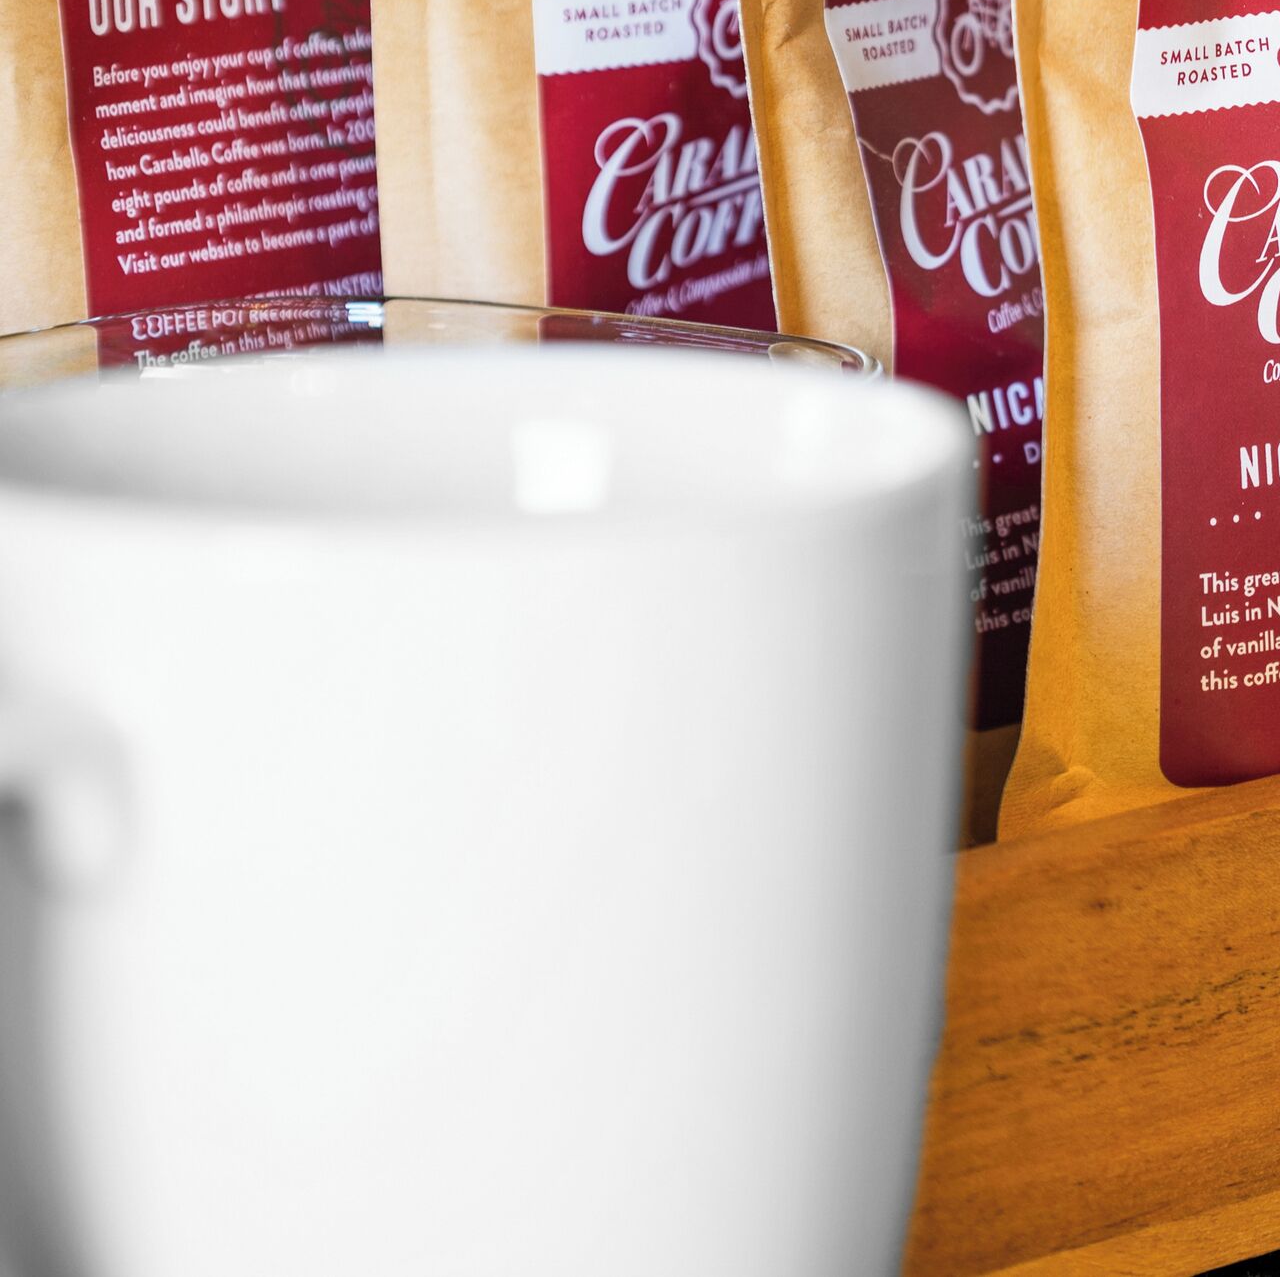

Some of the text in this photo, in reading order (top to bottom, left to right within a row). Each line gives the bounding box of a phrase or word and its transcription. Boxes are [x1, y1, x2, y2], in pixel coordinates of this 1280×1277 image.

[563, 4, 620, 22] SMALL
[585, 21, 664, 42] ROASTED
[845, 14, 927, 42] SMALL BATCH
[93, 64, 139, 87] Before
[142, 63, 168, 87] you
[171, 53, 208, 81] enjoy
[212, 53, 243, 77] your
[247, 49, 273, 70] cup
[275, 36, 290, 60] of
[862, 39, 915, 61] ROASTED
[1160, 37, 1269, 65] SMALL BATCH
[1177, 63, 1252, 85] ROASTED
[95, 95, 156, 119] moment
[160, 87, 186, 109] and
[188, 81, 245, 109] imagine
[246, 75, 275, 97] how
[278, 71, 309, 91] that
[100, 124, 195, 150] deliciousness
[197, 111, 234, 135] could
[237, 101, 287, 129] benefit
[289, 97, 327, 121] other
[105, 160, 137, 181] how
[139, 147, 209, 176] Carabello
[211, 139, 258, 163] Coffee
[261, 138, 286, 156] was
[327, 124, 342, 146] In
[112, 189, 151, 218] eight
[154, 179, 206, 213] pounds
[209, 174, 224, 196] of
[227, 168, 268, 193] coffee
[271, 163, 296, 186] and
[299, 167, 307, 182] a
[310, 163, 335, 181] one
[116, 221, 145, 245] and
[148, 211, 201, 240] formed
[205, 215, 214, 229] a
[217, 194, 306, 234] philanthropic
[308, 185, 368, 212] roasting
[117, 251, 157, 275] Visit
[160, 251, 187, 270] our
[188, 237, 243, 266] website
[244, 237, 260, 254] to
[261, 228, 313, 251] become
[317, 225, 326, 242] a
[328, 218, 357, 248] part
[171, 339, 217, 365] coffee
[221, 337, 235, 355] in
[239, 330, 265, 352] this
[267, 324, 292, 350] bag
[996, 504, 1039, 537] great
[1002, 542, 1020, 560] in
[969, 578, 988, 602] of
[1199, 571, 1239, 594] This
[976, 612, 1007, 634] this
[1201, 604, 1240, 627] Luis
[1245, 602, 1261, 621] in
[1200, 636, 1223, 659] of
[1200, 669, 1238, 691] this
